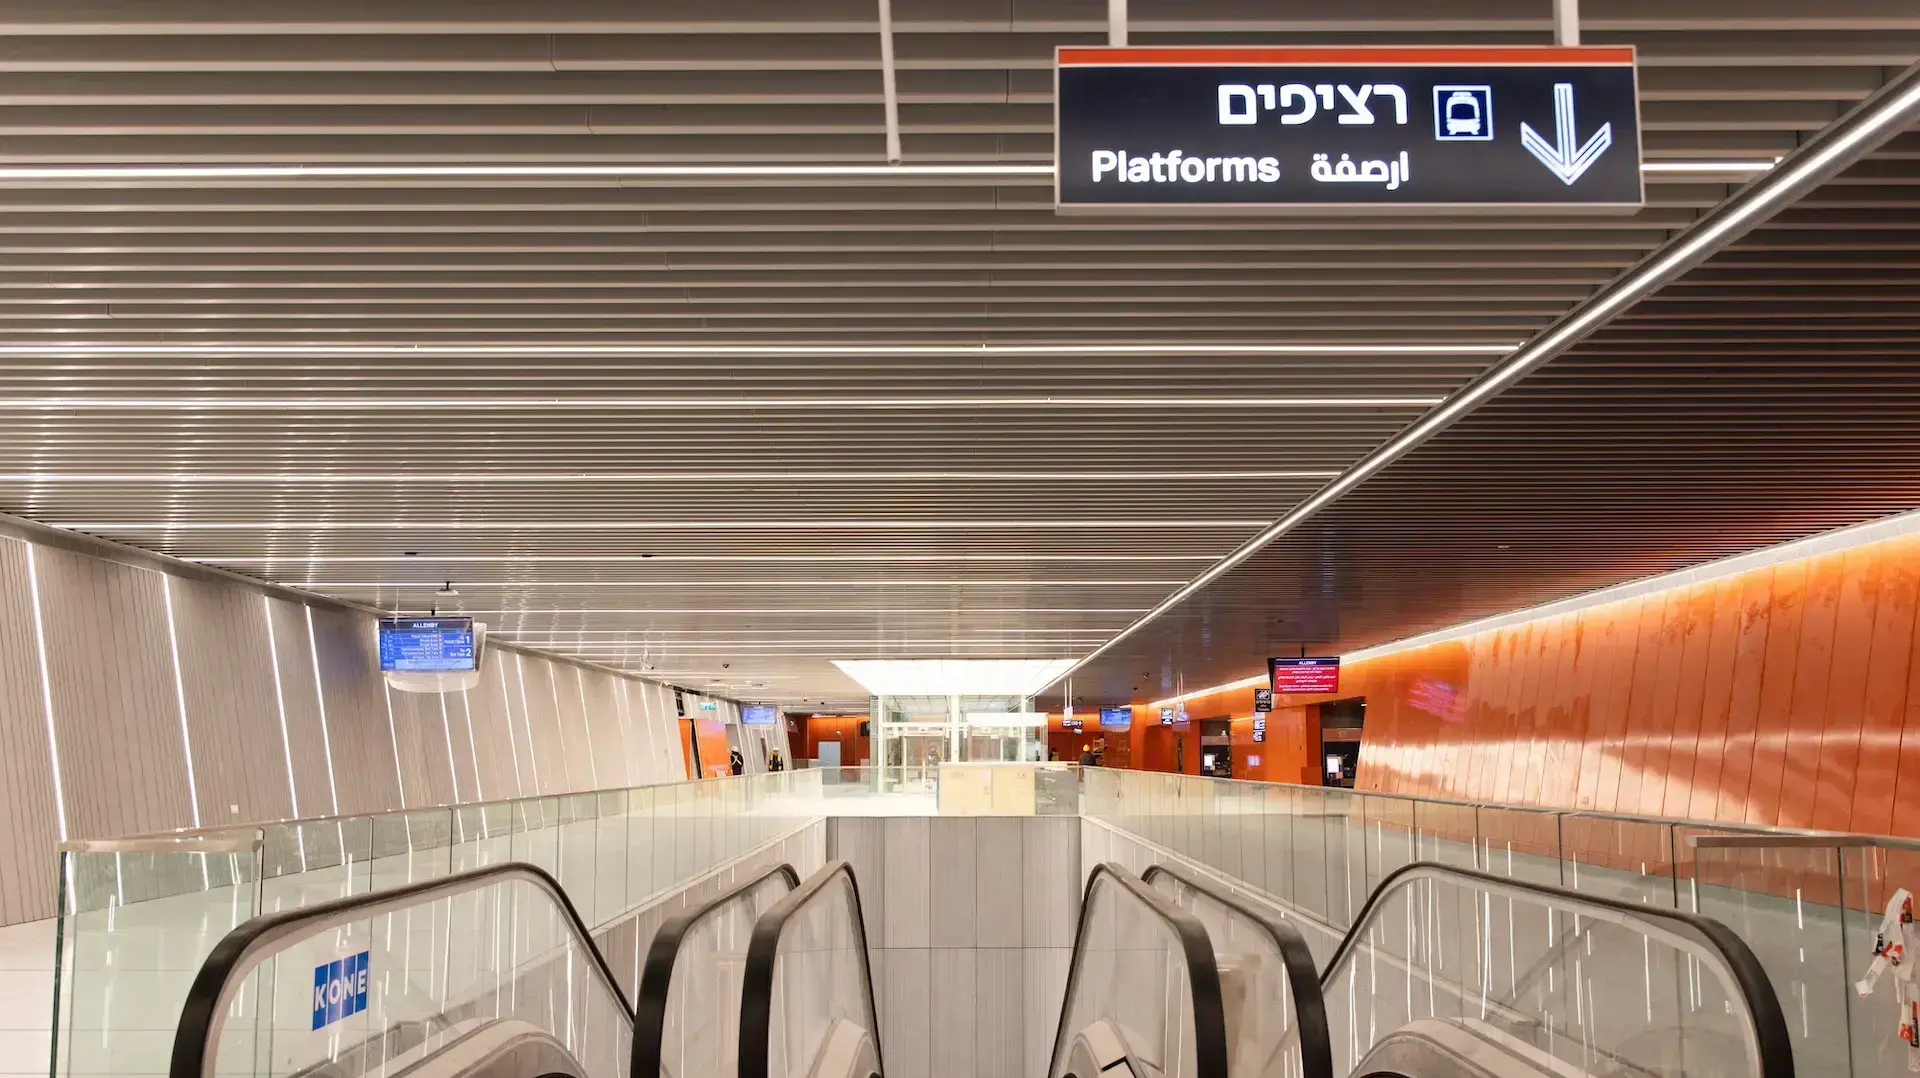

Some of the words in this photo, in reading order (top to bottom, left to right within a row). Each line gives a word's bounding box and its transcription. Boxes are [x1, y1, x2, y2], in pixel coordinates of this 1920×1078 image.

[1218, 84, 1407, 124] רציפים
[1092, 150, 1280, 182] Platforms
[465, 635, 470, 645] 1
[465, 647, 472, 657] 2
[314, 969, 367, 1011] KONE
